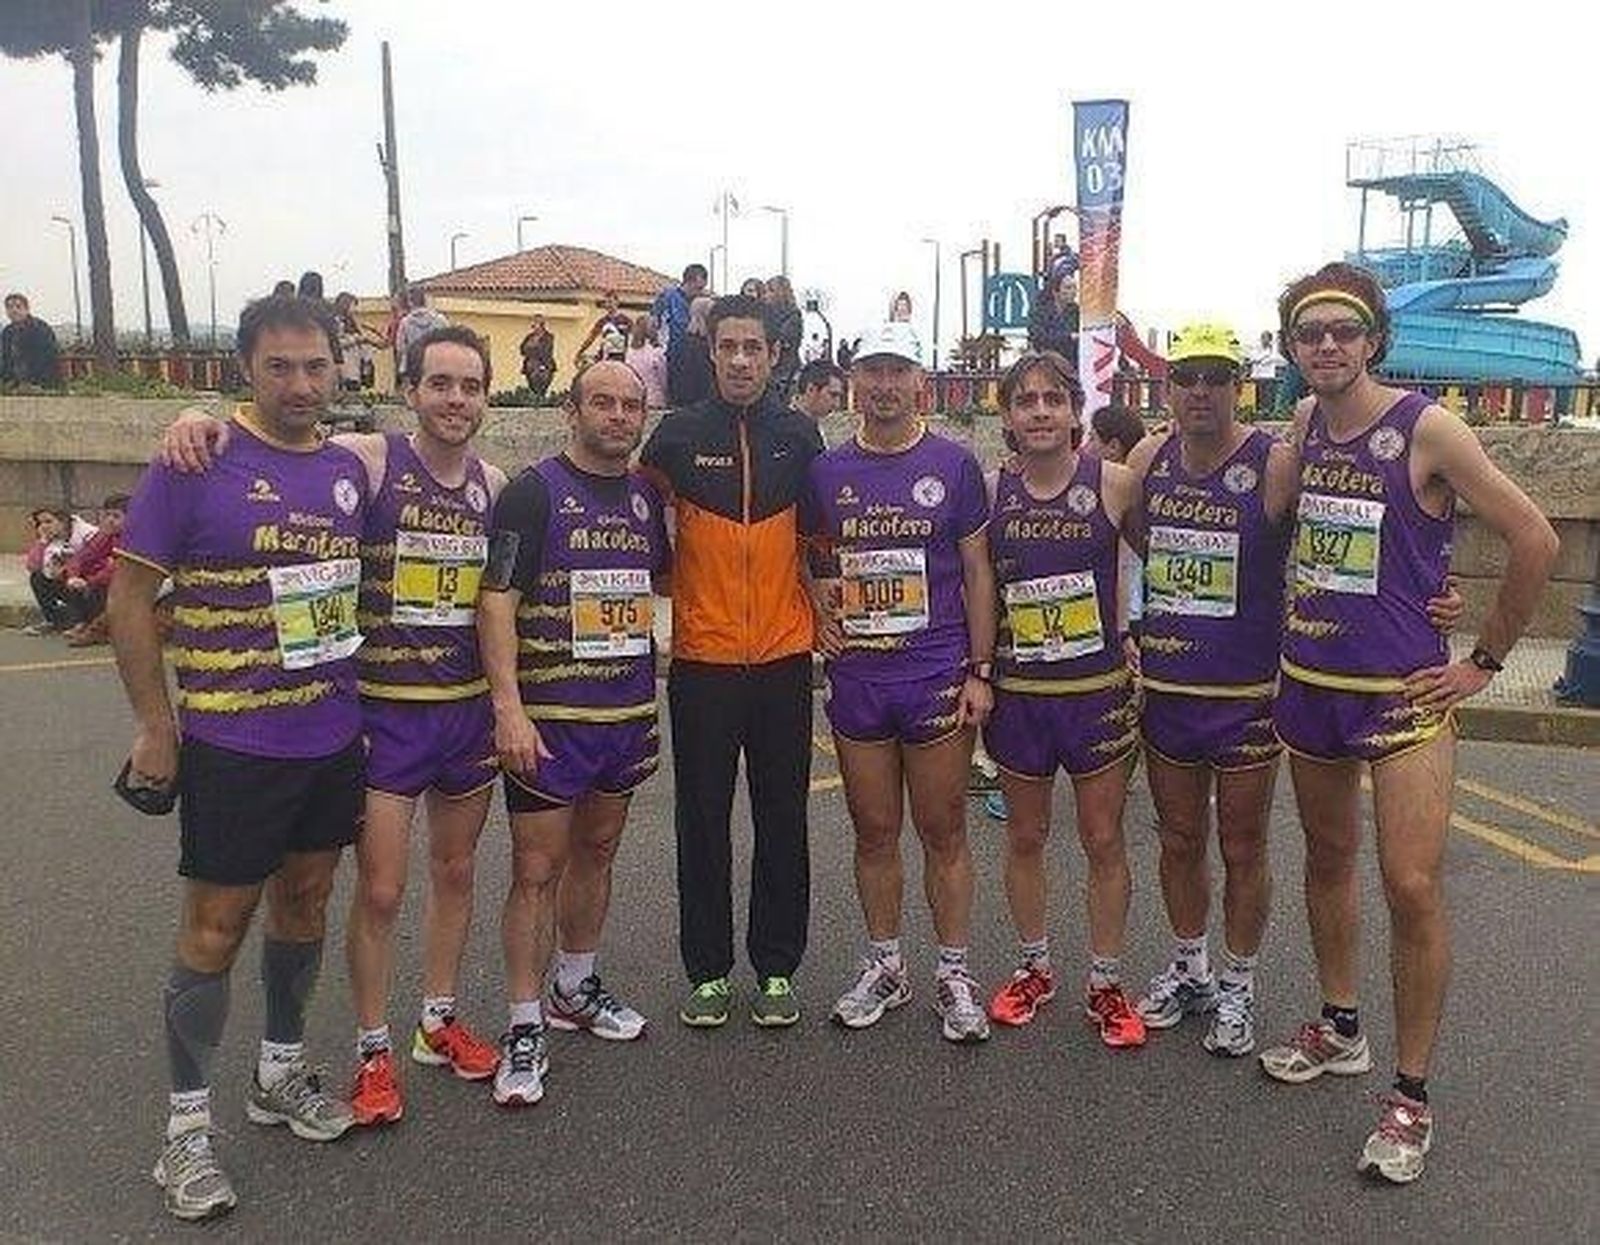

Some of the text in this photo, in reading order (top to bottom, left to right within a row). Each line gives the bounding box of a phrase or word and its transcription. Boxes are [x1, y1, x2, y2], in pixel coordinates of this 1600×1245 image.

[1082, 125, 1124, 158] KM
[1087, 163, 1122, 193] 03
[436, 566, 459, 594] 13
[1166, 558, 1214, 588] 1340
[601, 599, 638, 627] 975
